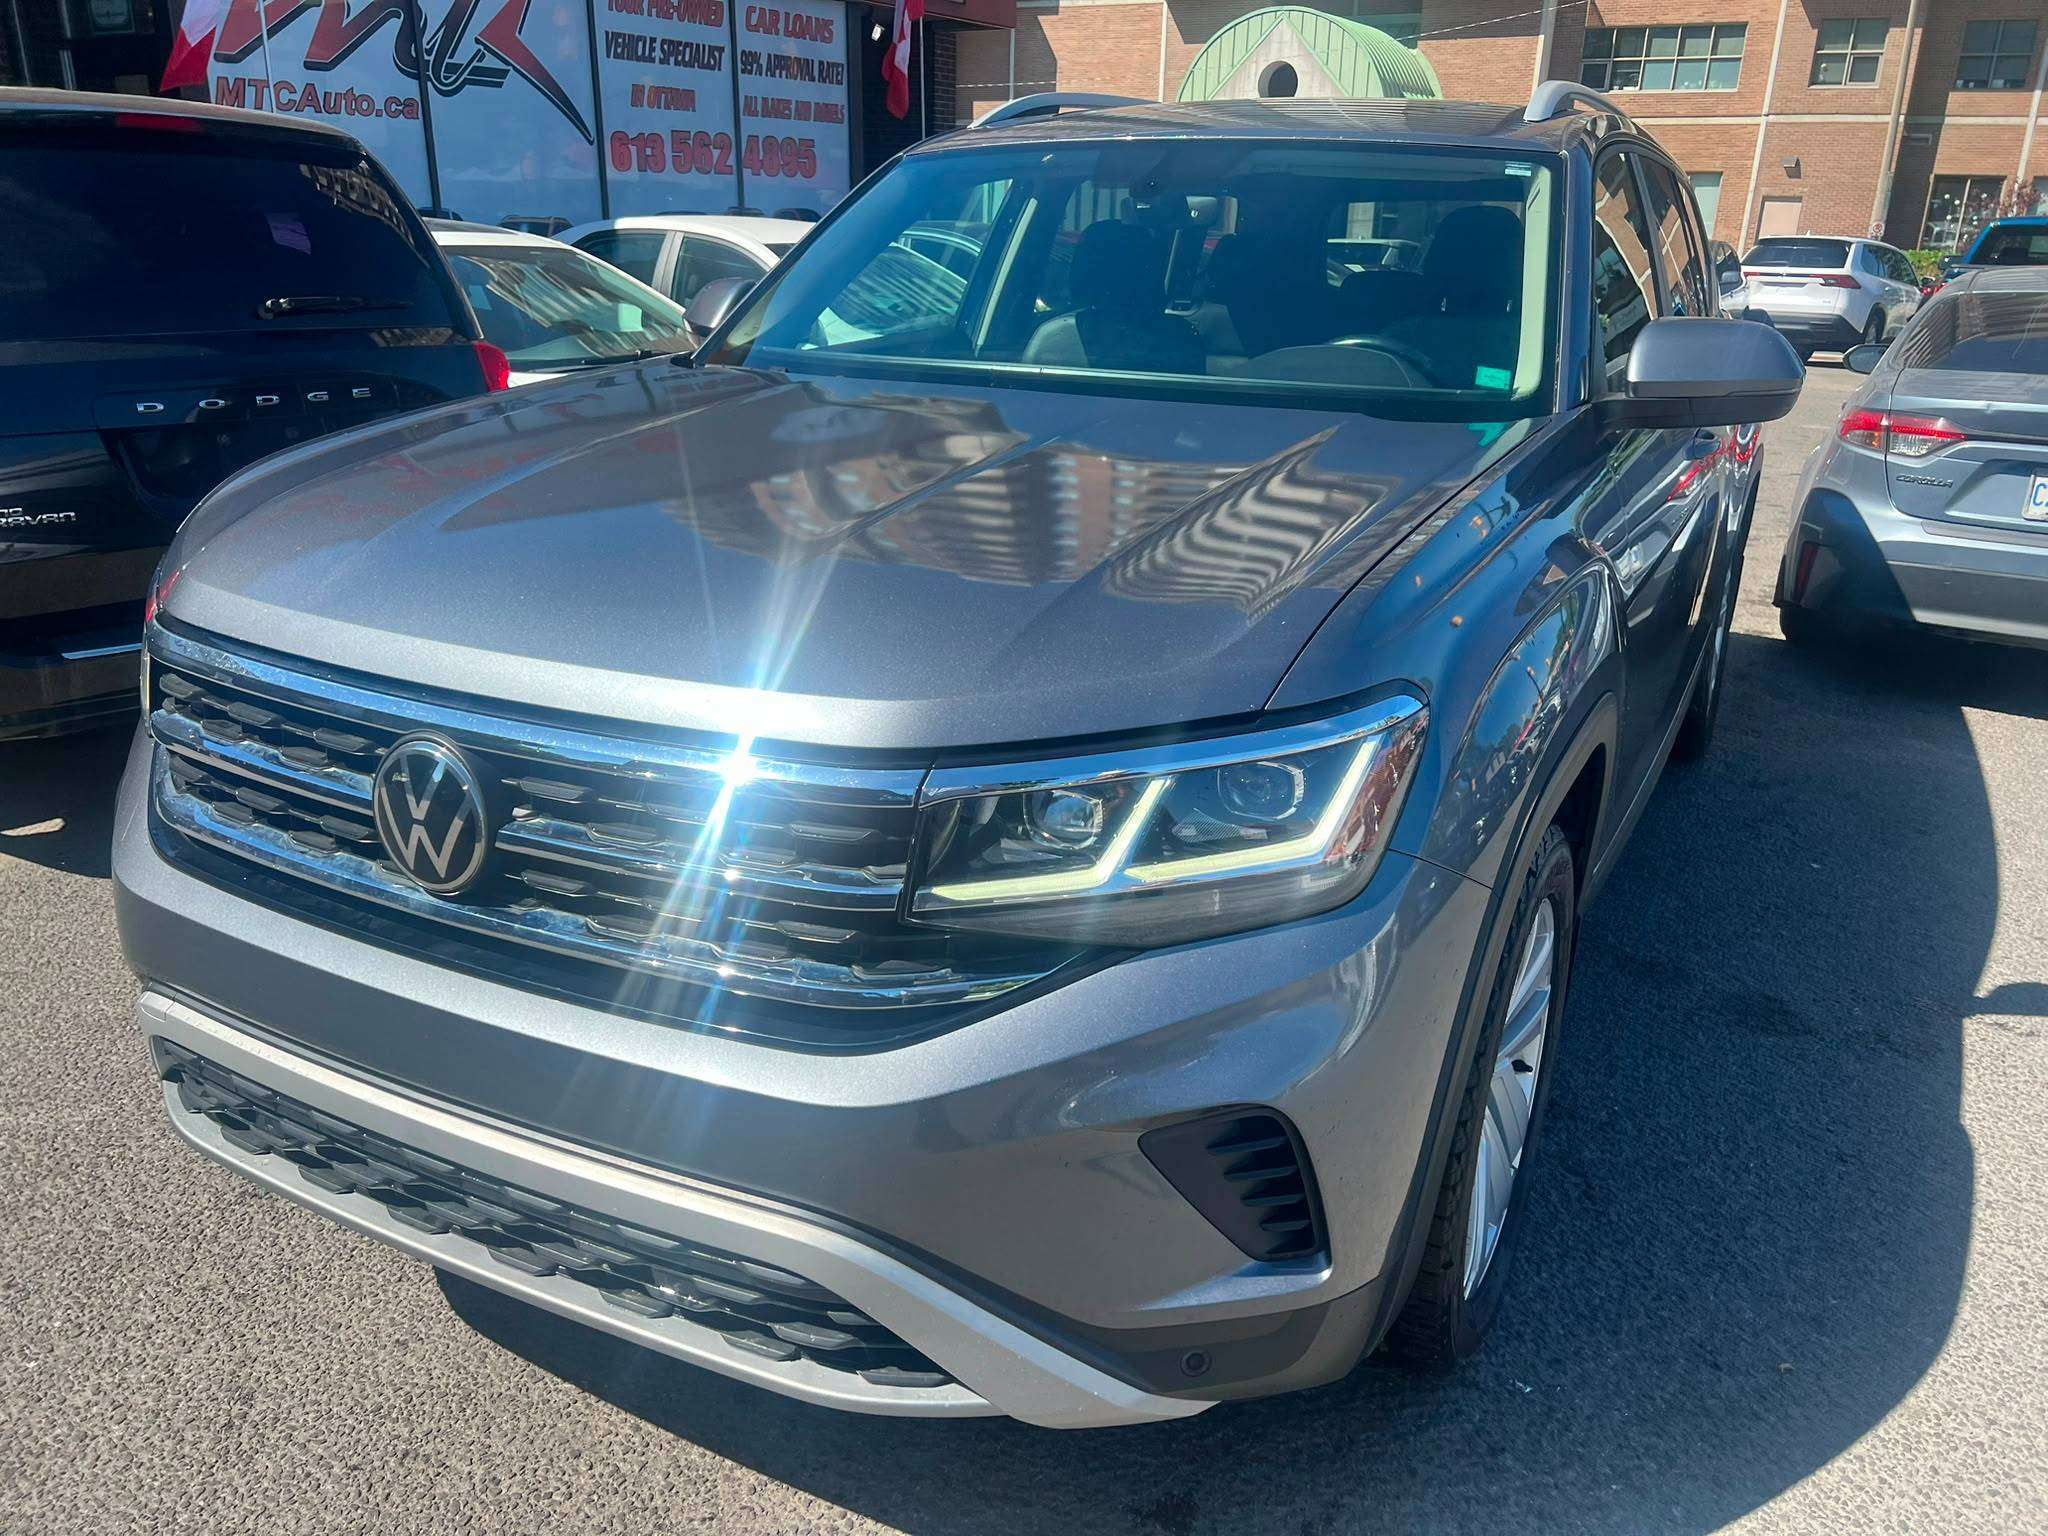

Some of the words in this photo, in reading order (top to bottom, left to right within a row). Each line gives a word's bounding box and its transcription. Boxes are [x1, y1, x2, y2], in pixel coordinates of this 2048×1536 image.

[647, 0, 724, 27] PRE-OWNED
[745, 5, 780, 36] CAR
[783, 11, 834, 44] LOANS
[604, 30, 657, 64] VEHICLE
[659, 38, 725, 72] SPECIALIST
[740, 49, 763, 77] 99%
[765, 53, 816, 82] APPROVAL
[817, 60, 844, 86] RATE!
[214, 75, 421, 120] MTCAuto.ca
[610, 130, 667, 174] 613
[670, 129, 735, 176] 562
[742, 134, 817, 179] 4895
[136, 386, 372, 415] DODGE
